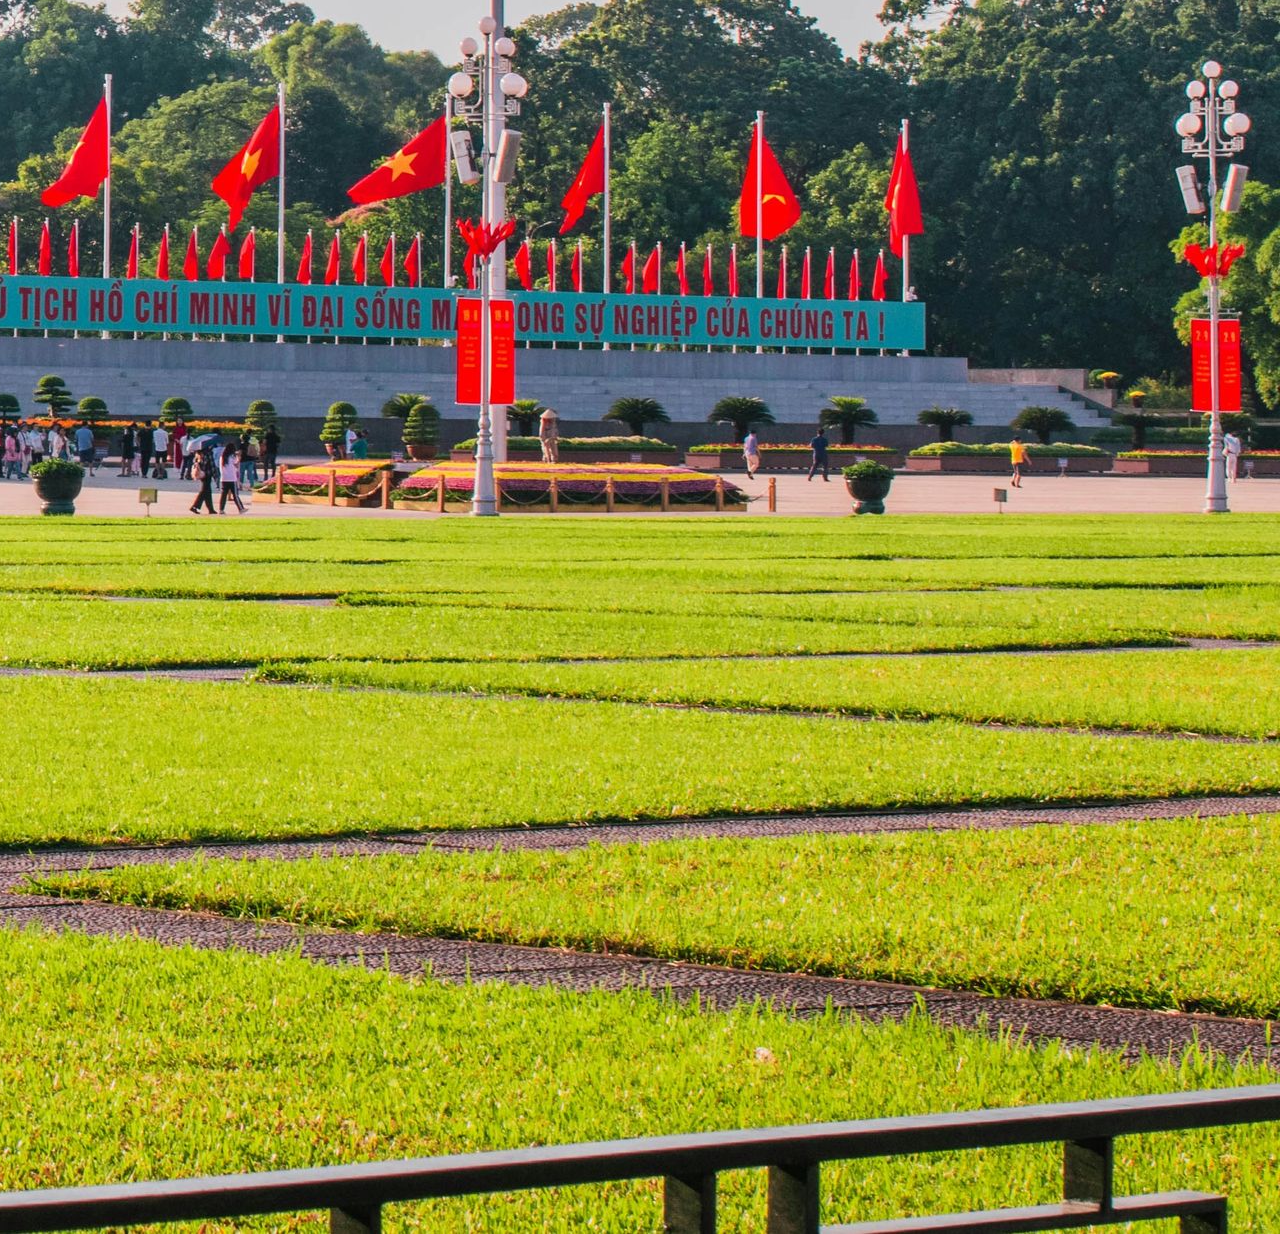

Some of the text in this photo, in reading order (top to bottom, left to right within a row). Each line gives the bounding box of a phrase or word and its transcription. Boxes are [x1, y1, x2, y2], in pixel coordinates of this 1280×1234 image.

[19, 287, 78, 327] TỊCH
[90, 279, 123, 322] HỒ
[135, 285, 178, 323] CHÍ
[190, 292, 256, 326] MINH
[268, 289, 292, 327] VĨ
[302, 295, 343, 334] ĐẠI
[355, 288, 420, 329] SỐNG
[575, 300, 606, 341] SỰ
[614, 299, 698, 342] NGHIỆP
[706, 298, 750, 338] CỦA
[759, 302, 834, 341] CHÚNG
[843, 310, 869, 341] TA
